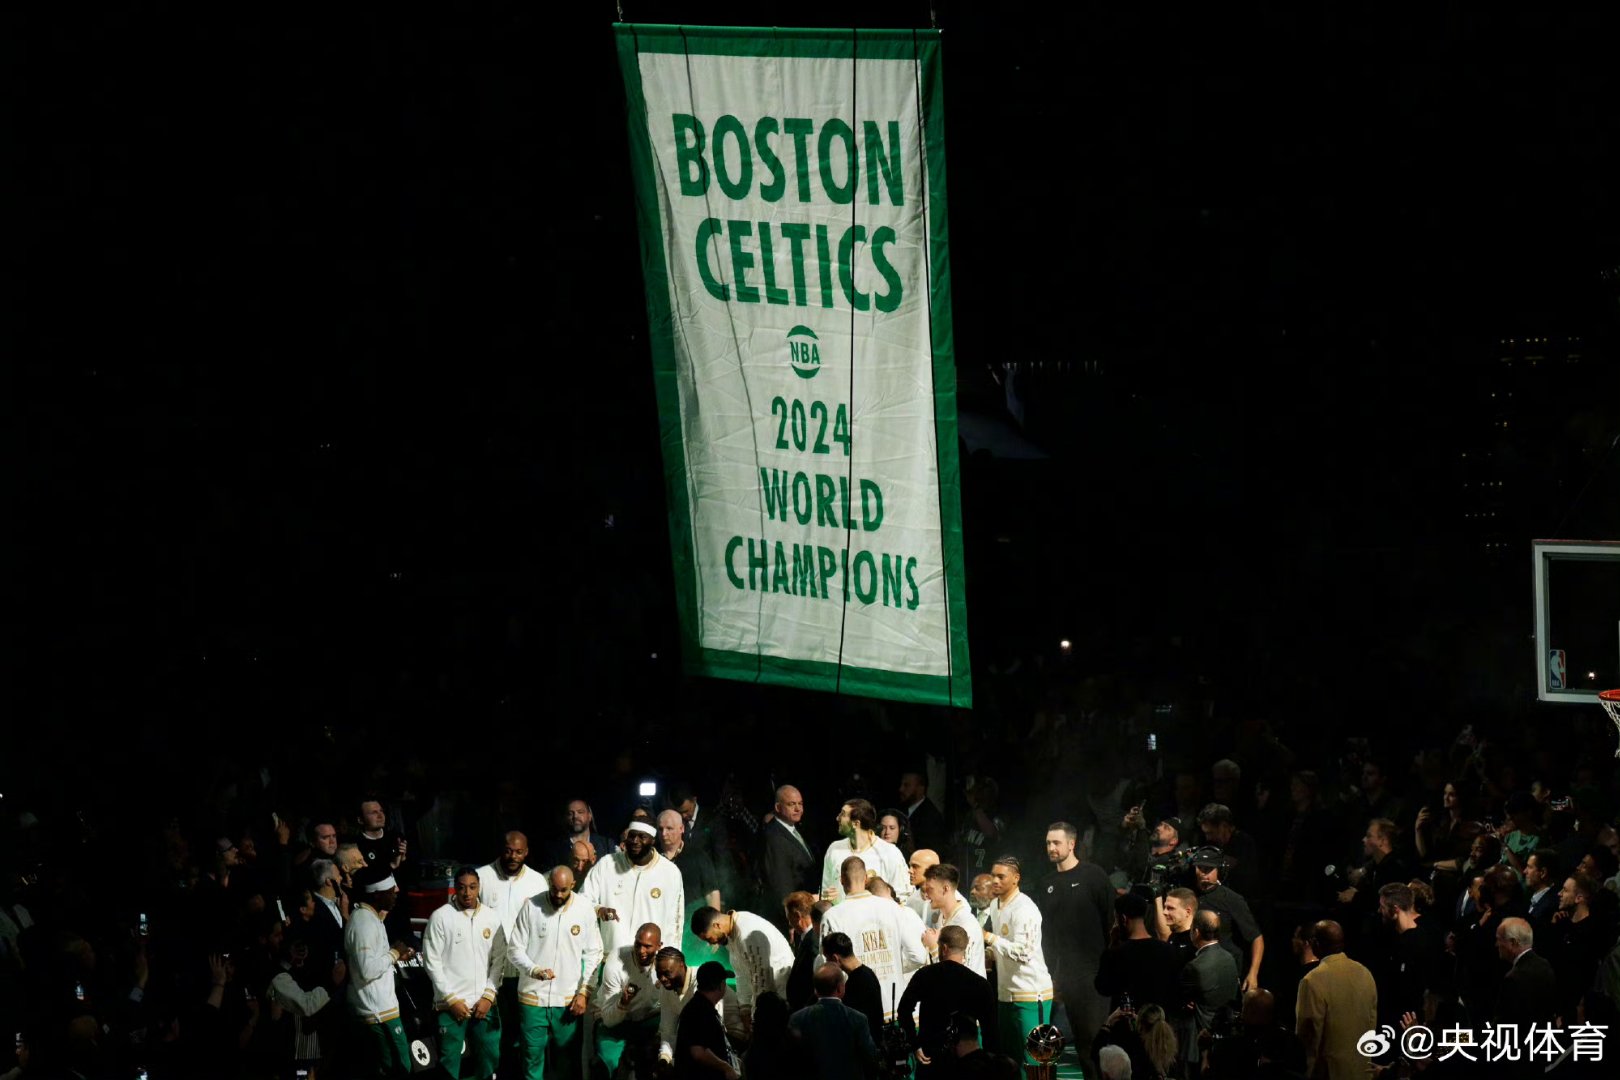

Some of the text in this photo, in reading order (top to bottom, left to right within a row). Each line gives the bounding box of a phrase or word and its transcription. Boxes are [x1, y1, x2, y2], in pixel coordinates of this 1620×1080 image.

[672, 113, 905, 207] BOSTON
[695, 217, 904, 313] CELTICS
[790, 341, 821, 365] NBA
[771, 395, 851, 456] 2024
[760, 466, 884, 532] WORLD
[724, 535, 920, 611] CHAMPIONS
